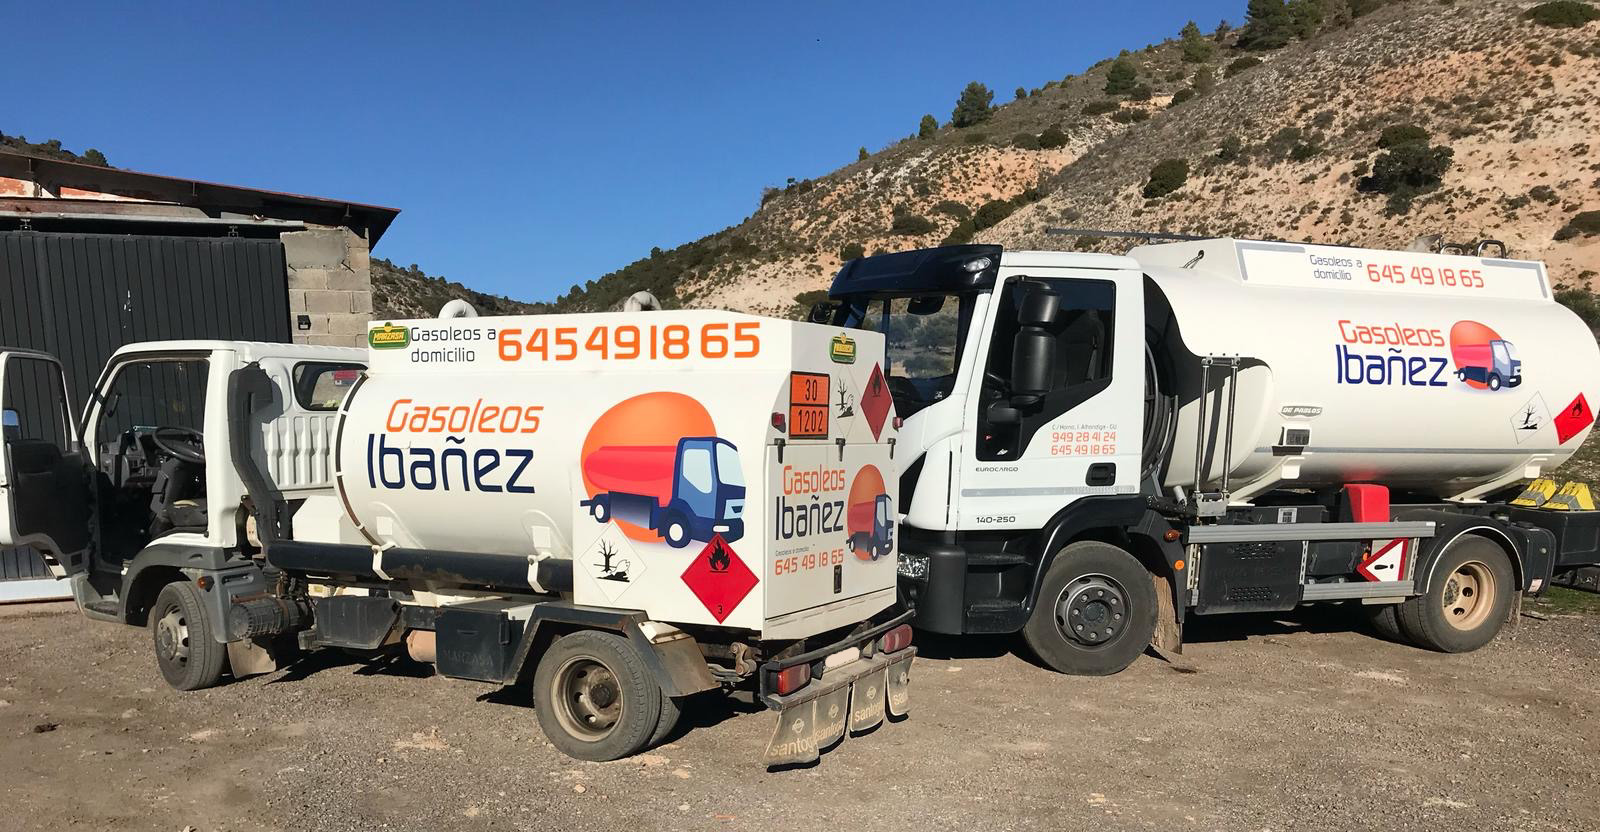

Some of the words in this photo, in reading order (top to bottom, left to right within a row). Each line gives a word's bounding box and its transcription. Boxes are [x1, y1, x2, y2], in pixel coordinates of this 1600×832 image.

[1309, 254, 1353, 267] Gasoleos
[1356, 259, 1363, 267] a
[1313, 269, 1352, 281] domicilio
[1367, 264, 1405, 284] 645
[1410, 266, 1435, 285] 49
[1438, 268, 1457, 287] 18
[1460, 269, 1484, 288] 65
[411, 326, 480, 341] Gasoleos
[487, 328, 496, 340] a
[1338, 320, 1445, 347] Gasoleos
[411, 348, 475, 362] domicilio
[1336, 344, 1448, 387] Ibañez
[805, 379, 818, 401] 30
[386, 398, 544, 433] Gasoleos
[798, 409, 823, 432] 1202
[1052, 432, 1073, 442] 949
[1075, 432, 1090, 442] 28
[1092, 432, 1101, 442] 41
[1103, 432, 1116, 442] 24
[1051, 445, 1072, 455] 645
[1074, 445, 1088, 455] 49
[1090, 445, 1100, 455] 18
[1102, 444, 1116, 455] 65
[367, 433, 535, 494] Ibañez
[784, 464, 845, 495] Gasoleos
[776, 494, 844, 541] Ibañez
[976, 516, 1016, 524] 140-250
[775, 557, 798, 575] 645
[801, 554, 816, 571] 49
[818, 552, 828, 567] 18
[831, 548, 844, 565] 65
[718, 605, 723, 614] 3
